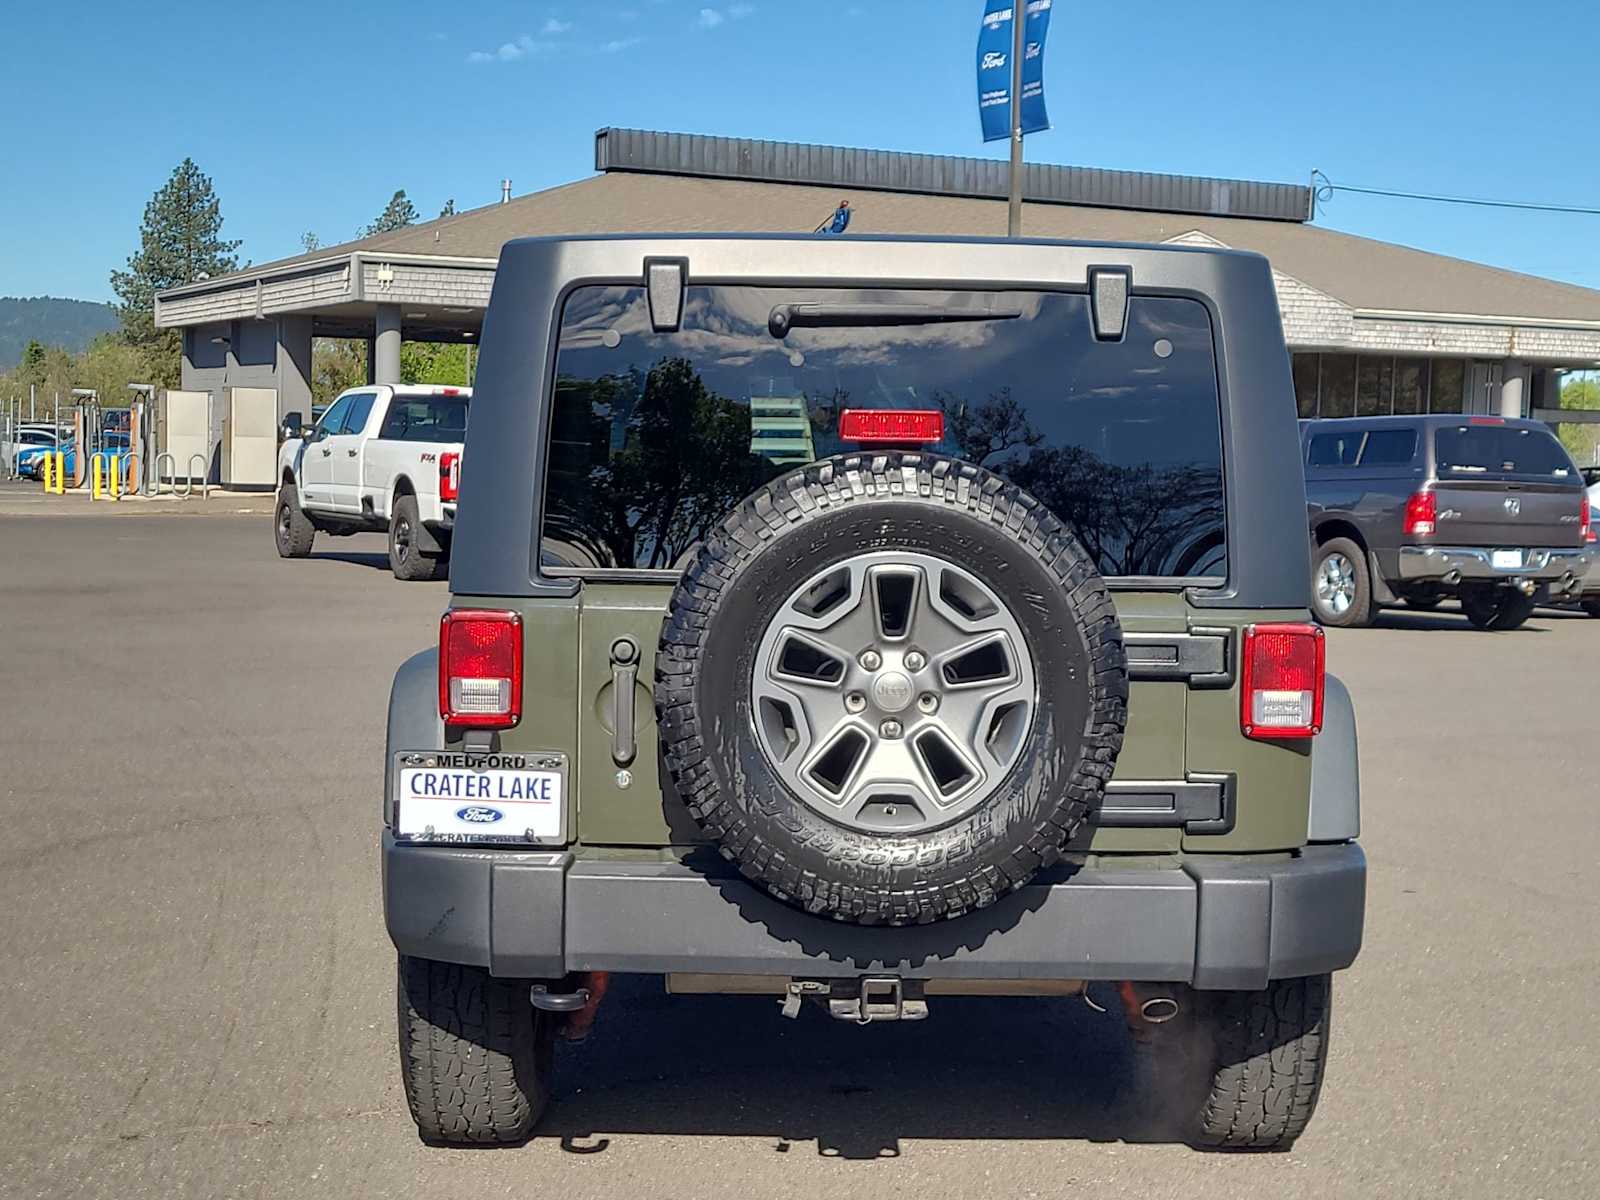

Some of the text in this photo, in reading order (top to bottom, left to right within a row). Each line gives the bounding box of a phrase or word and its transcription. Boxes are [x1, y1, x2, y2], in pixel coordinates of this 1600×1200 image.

[982, 52, 1007, 69] Ford
[436, 755, 526, 769] MEDFORD
[411, 773, 551, 800] CRATER LAKE
[463, 807, 495, 822] Ford
